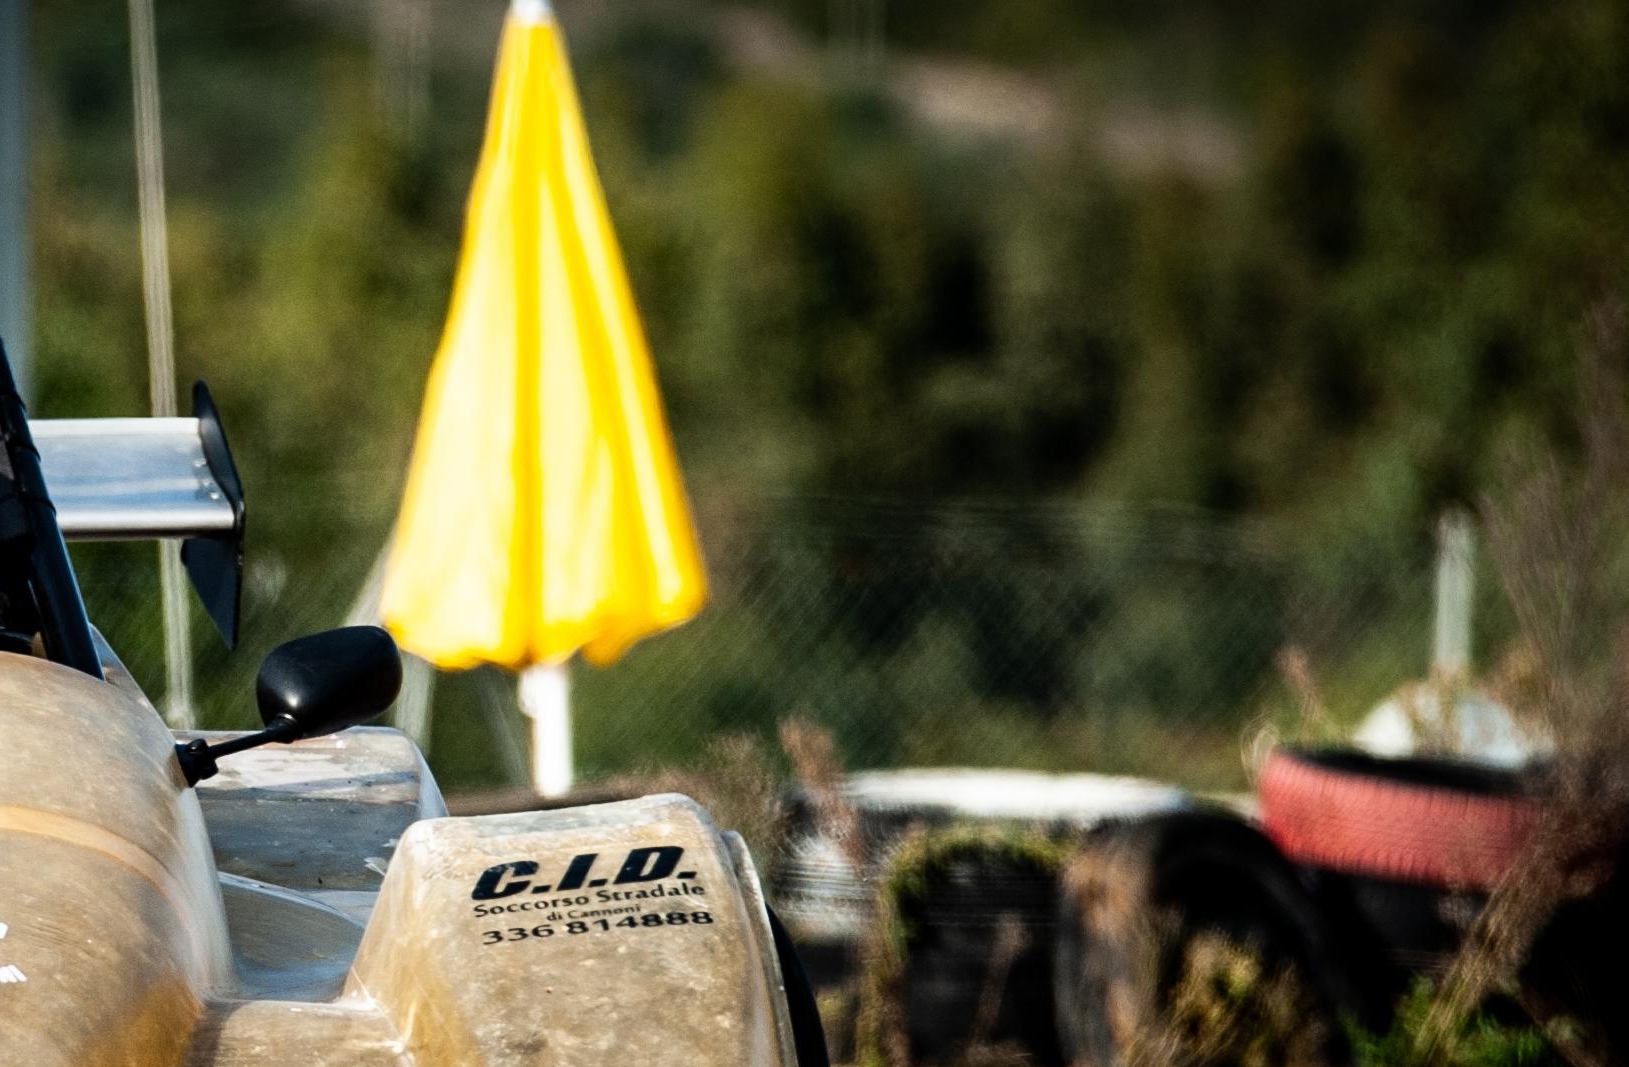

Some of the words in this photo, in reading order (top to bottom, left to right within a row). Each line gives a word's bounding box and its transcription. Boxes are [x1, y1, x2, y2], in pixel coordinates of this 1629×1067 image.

[471, 845, 698, 901] C.I.D.
[473, 893, 589, 918] Soccorso
[596, 881, 706, 903] Stradale
[546, 910, 563, 922] di
[567, 902, 642, 919] Cannoni
[482, 923, 555, 946] 336
[566, 910, 715, 936] 814888
